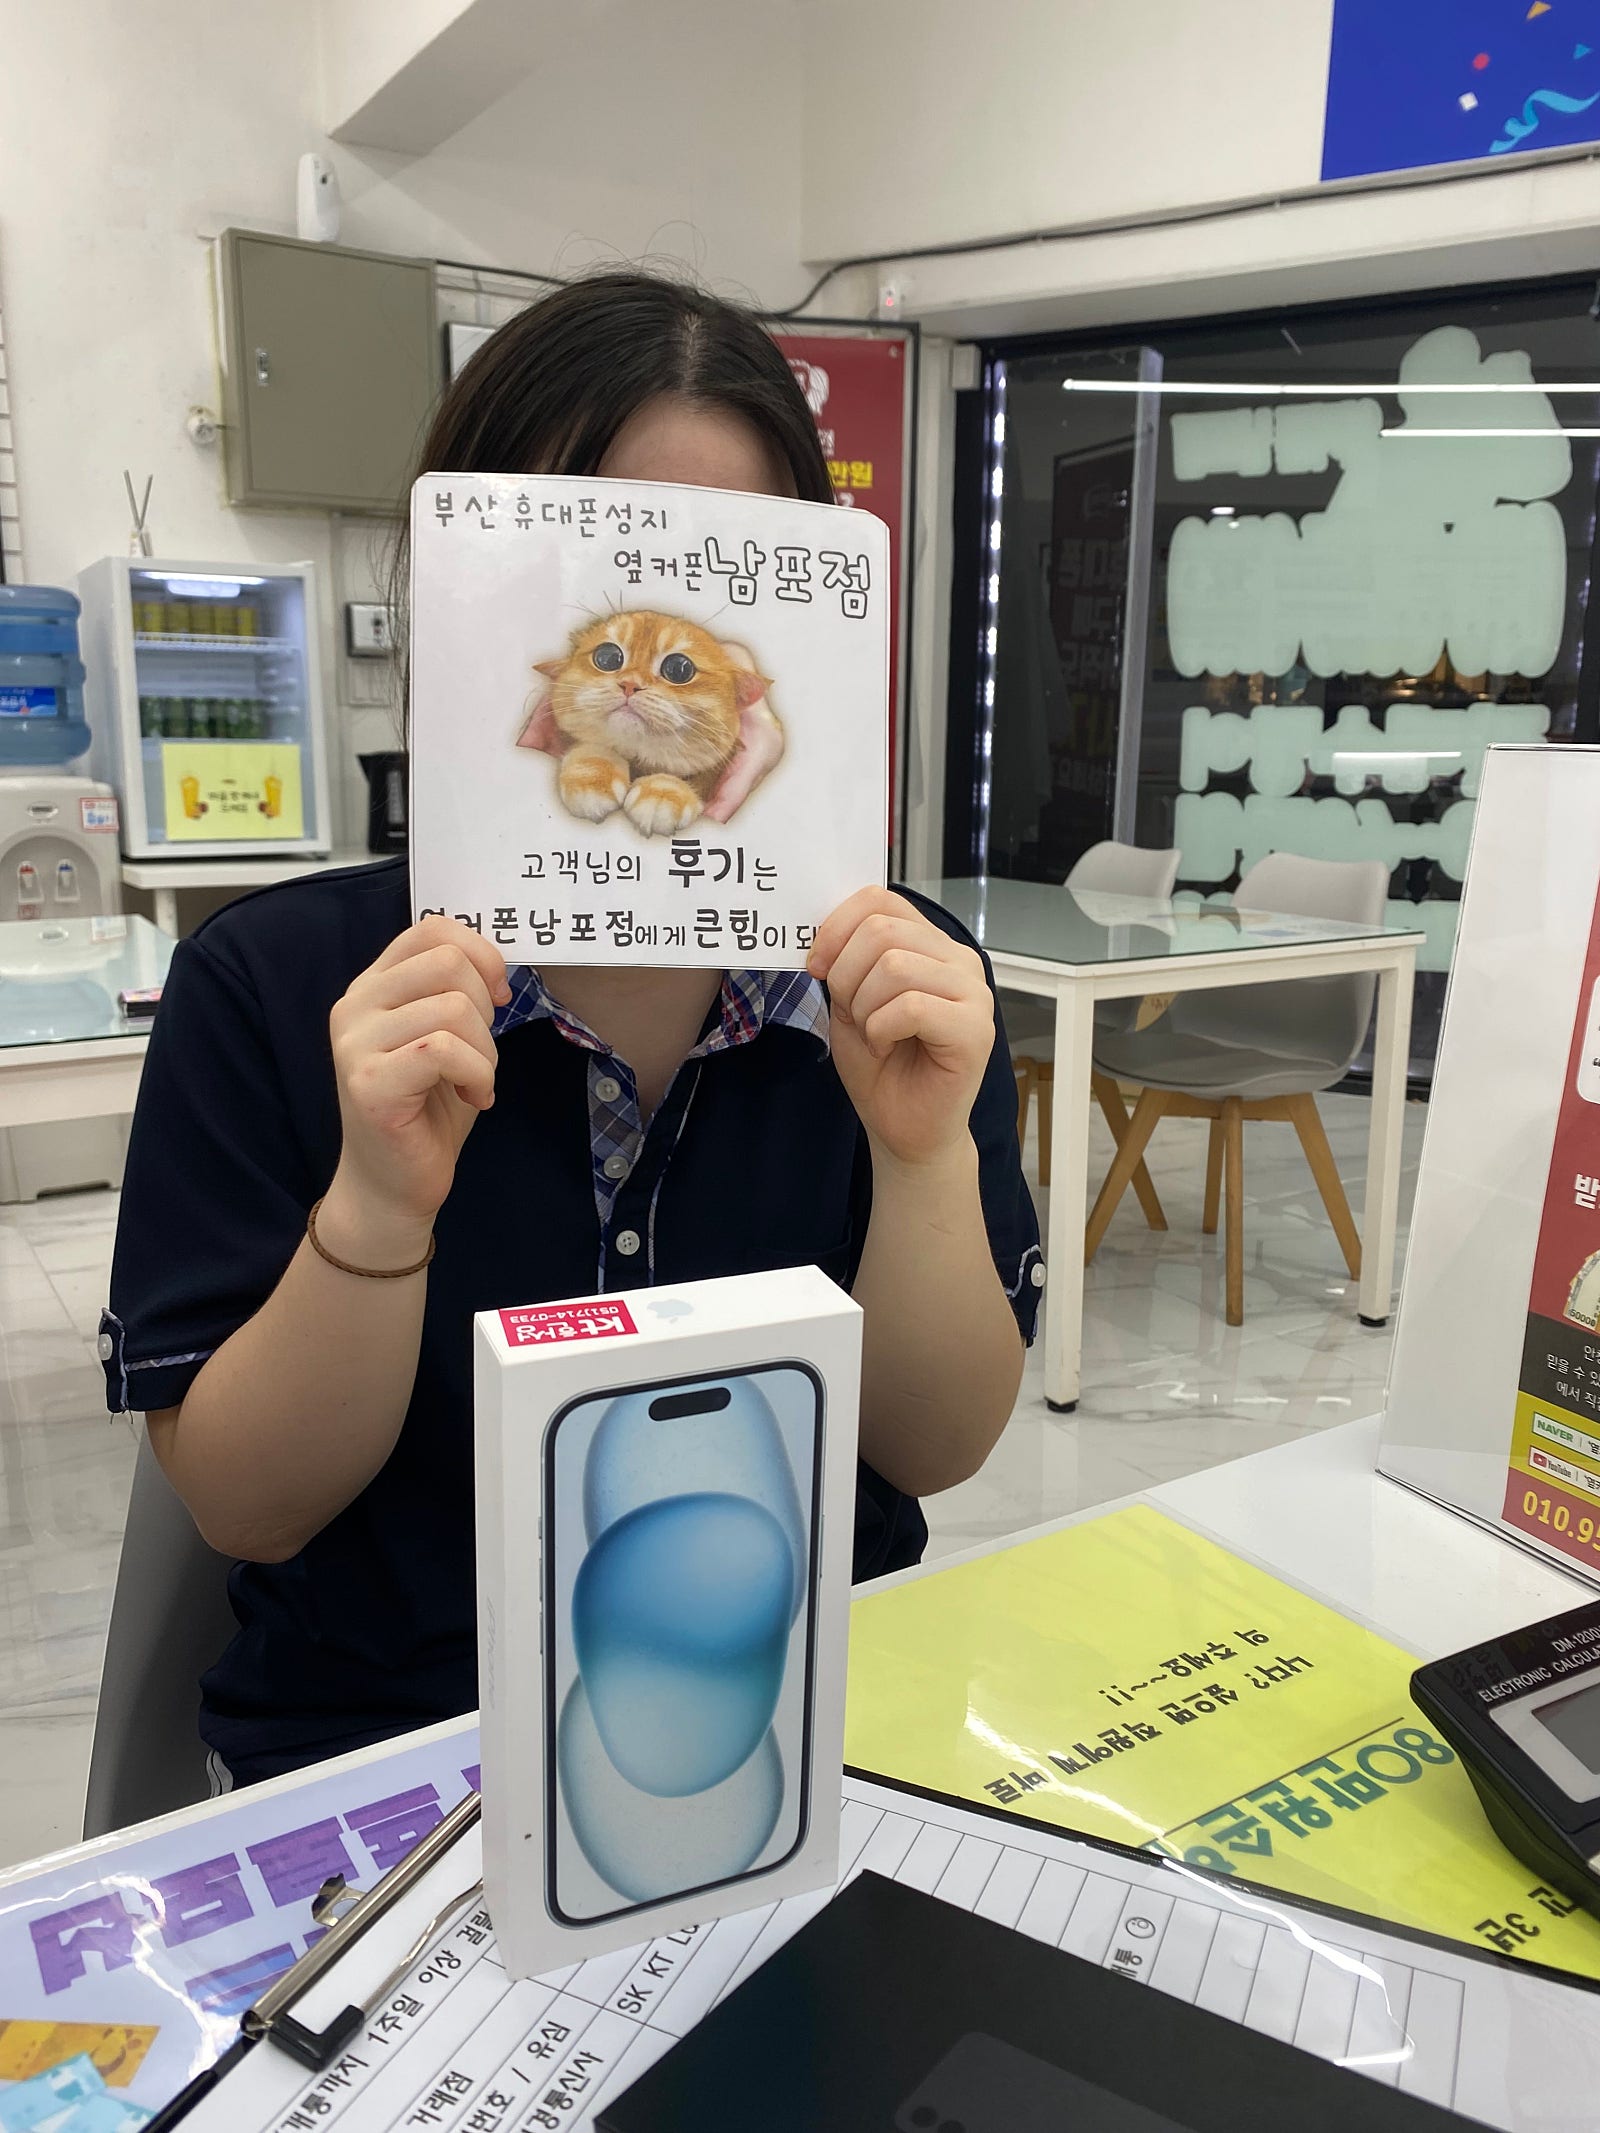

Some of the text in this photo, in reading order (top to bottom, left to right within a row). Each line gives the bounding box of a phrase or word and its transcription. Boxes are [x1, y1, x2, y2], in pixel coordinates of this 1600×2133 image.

[521, 839, 778, 891] 고객님의 후기는
[1546, 1353, 1569, 1375] 믿을
[1572, 1366, 1586, 1380] 수
[1556, 1381, 1581, 1402] 에서
[1536, 1419, 1574, 1443] NAVER
[1548, 1460, 1572, 1478] YouTube
[1477, 1667, 1552, 1703] ELECTRONIC
[983, 1655, 1314, 1805] 나다? 싶으면 직원에게 바로
[1473, 1912, 1541, 1954] 3년
[368, 1994, 425, 2045] 1주일
[418, 1949, 462, 1984] 이상
[617, 1984, 654, 2014] SK
[642, 1950, 674, 1979] KT
[527, 2021, 571, 2060] 유심
[406, 2071, 474, 2125] 거래점
